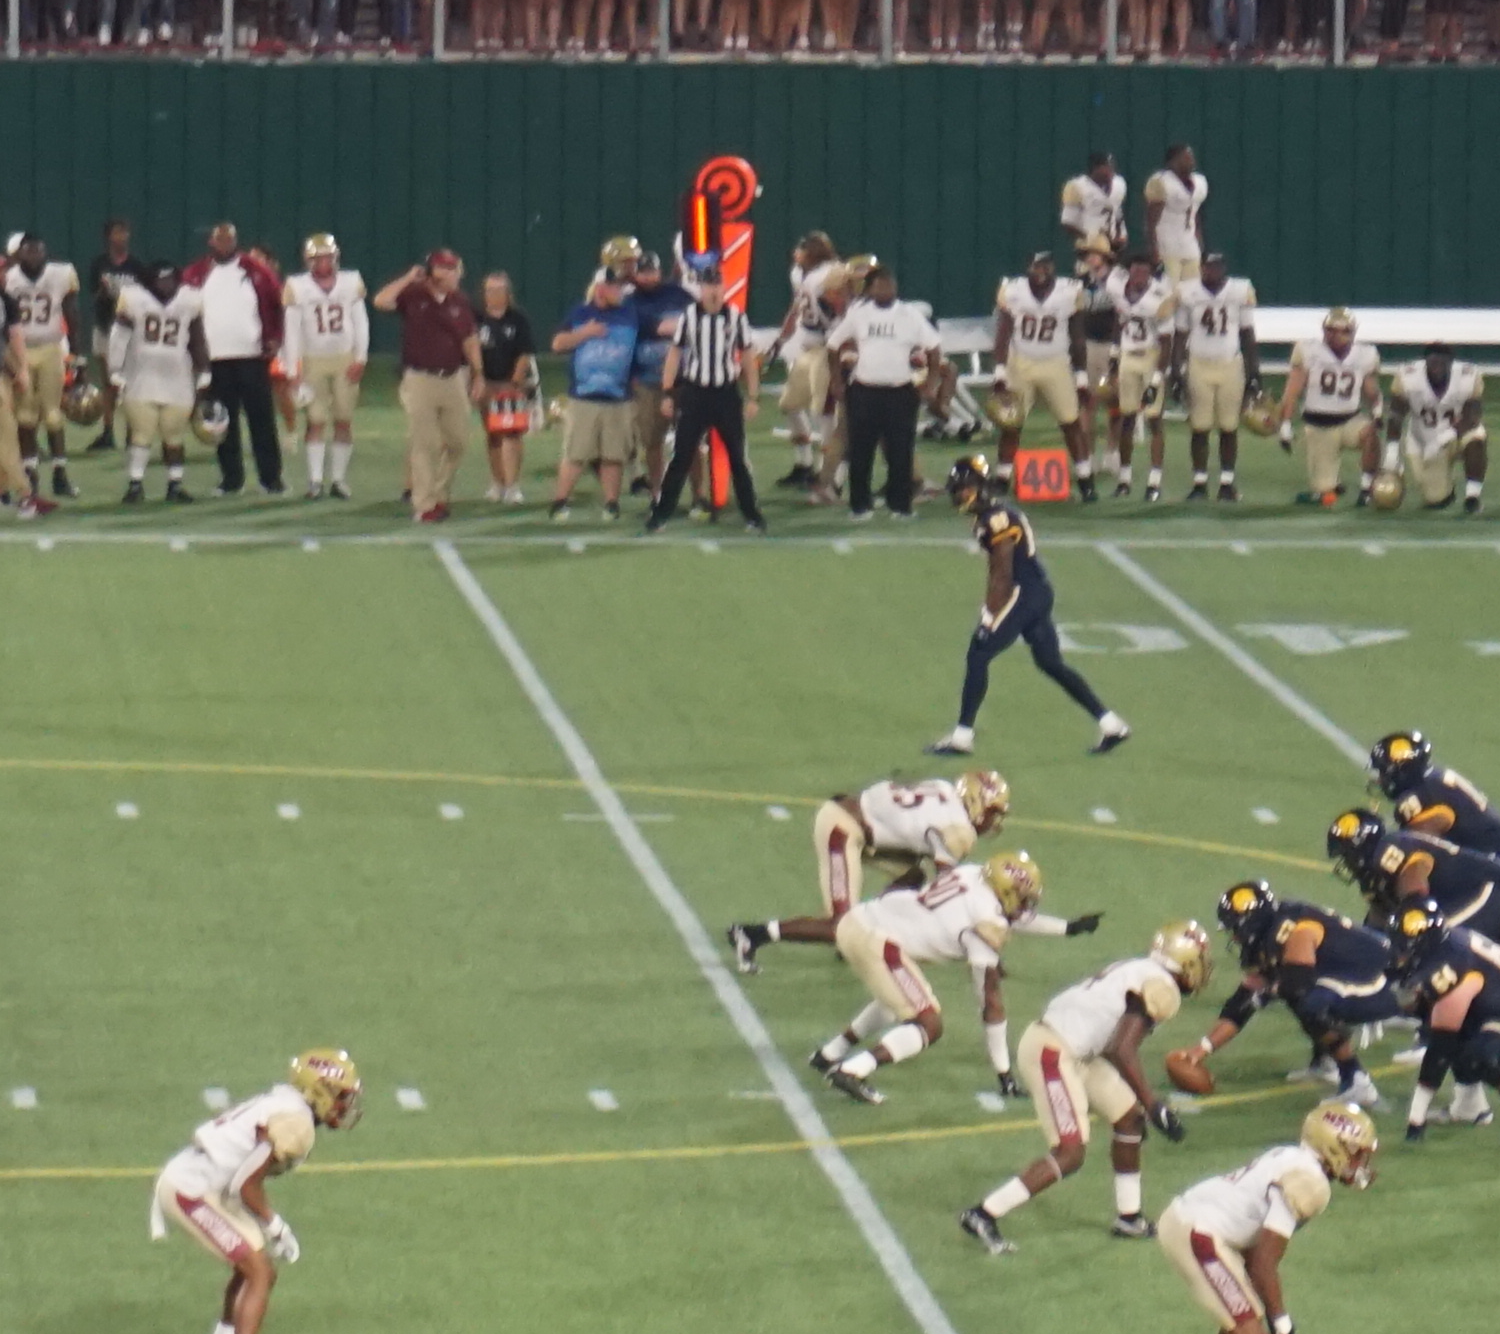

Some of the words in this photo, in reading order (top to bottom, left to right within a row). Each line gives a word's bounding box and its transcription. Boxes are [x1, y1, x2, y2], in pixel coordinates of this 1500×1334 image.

[314, 303, 344, 334] 12
[1201, 307, 1228, 336] 41
[1021, 458, 1064, 494] 40
